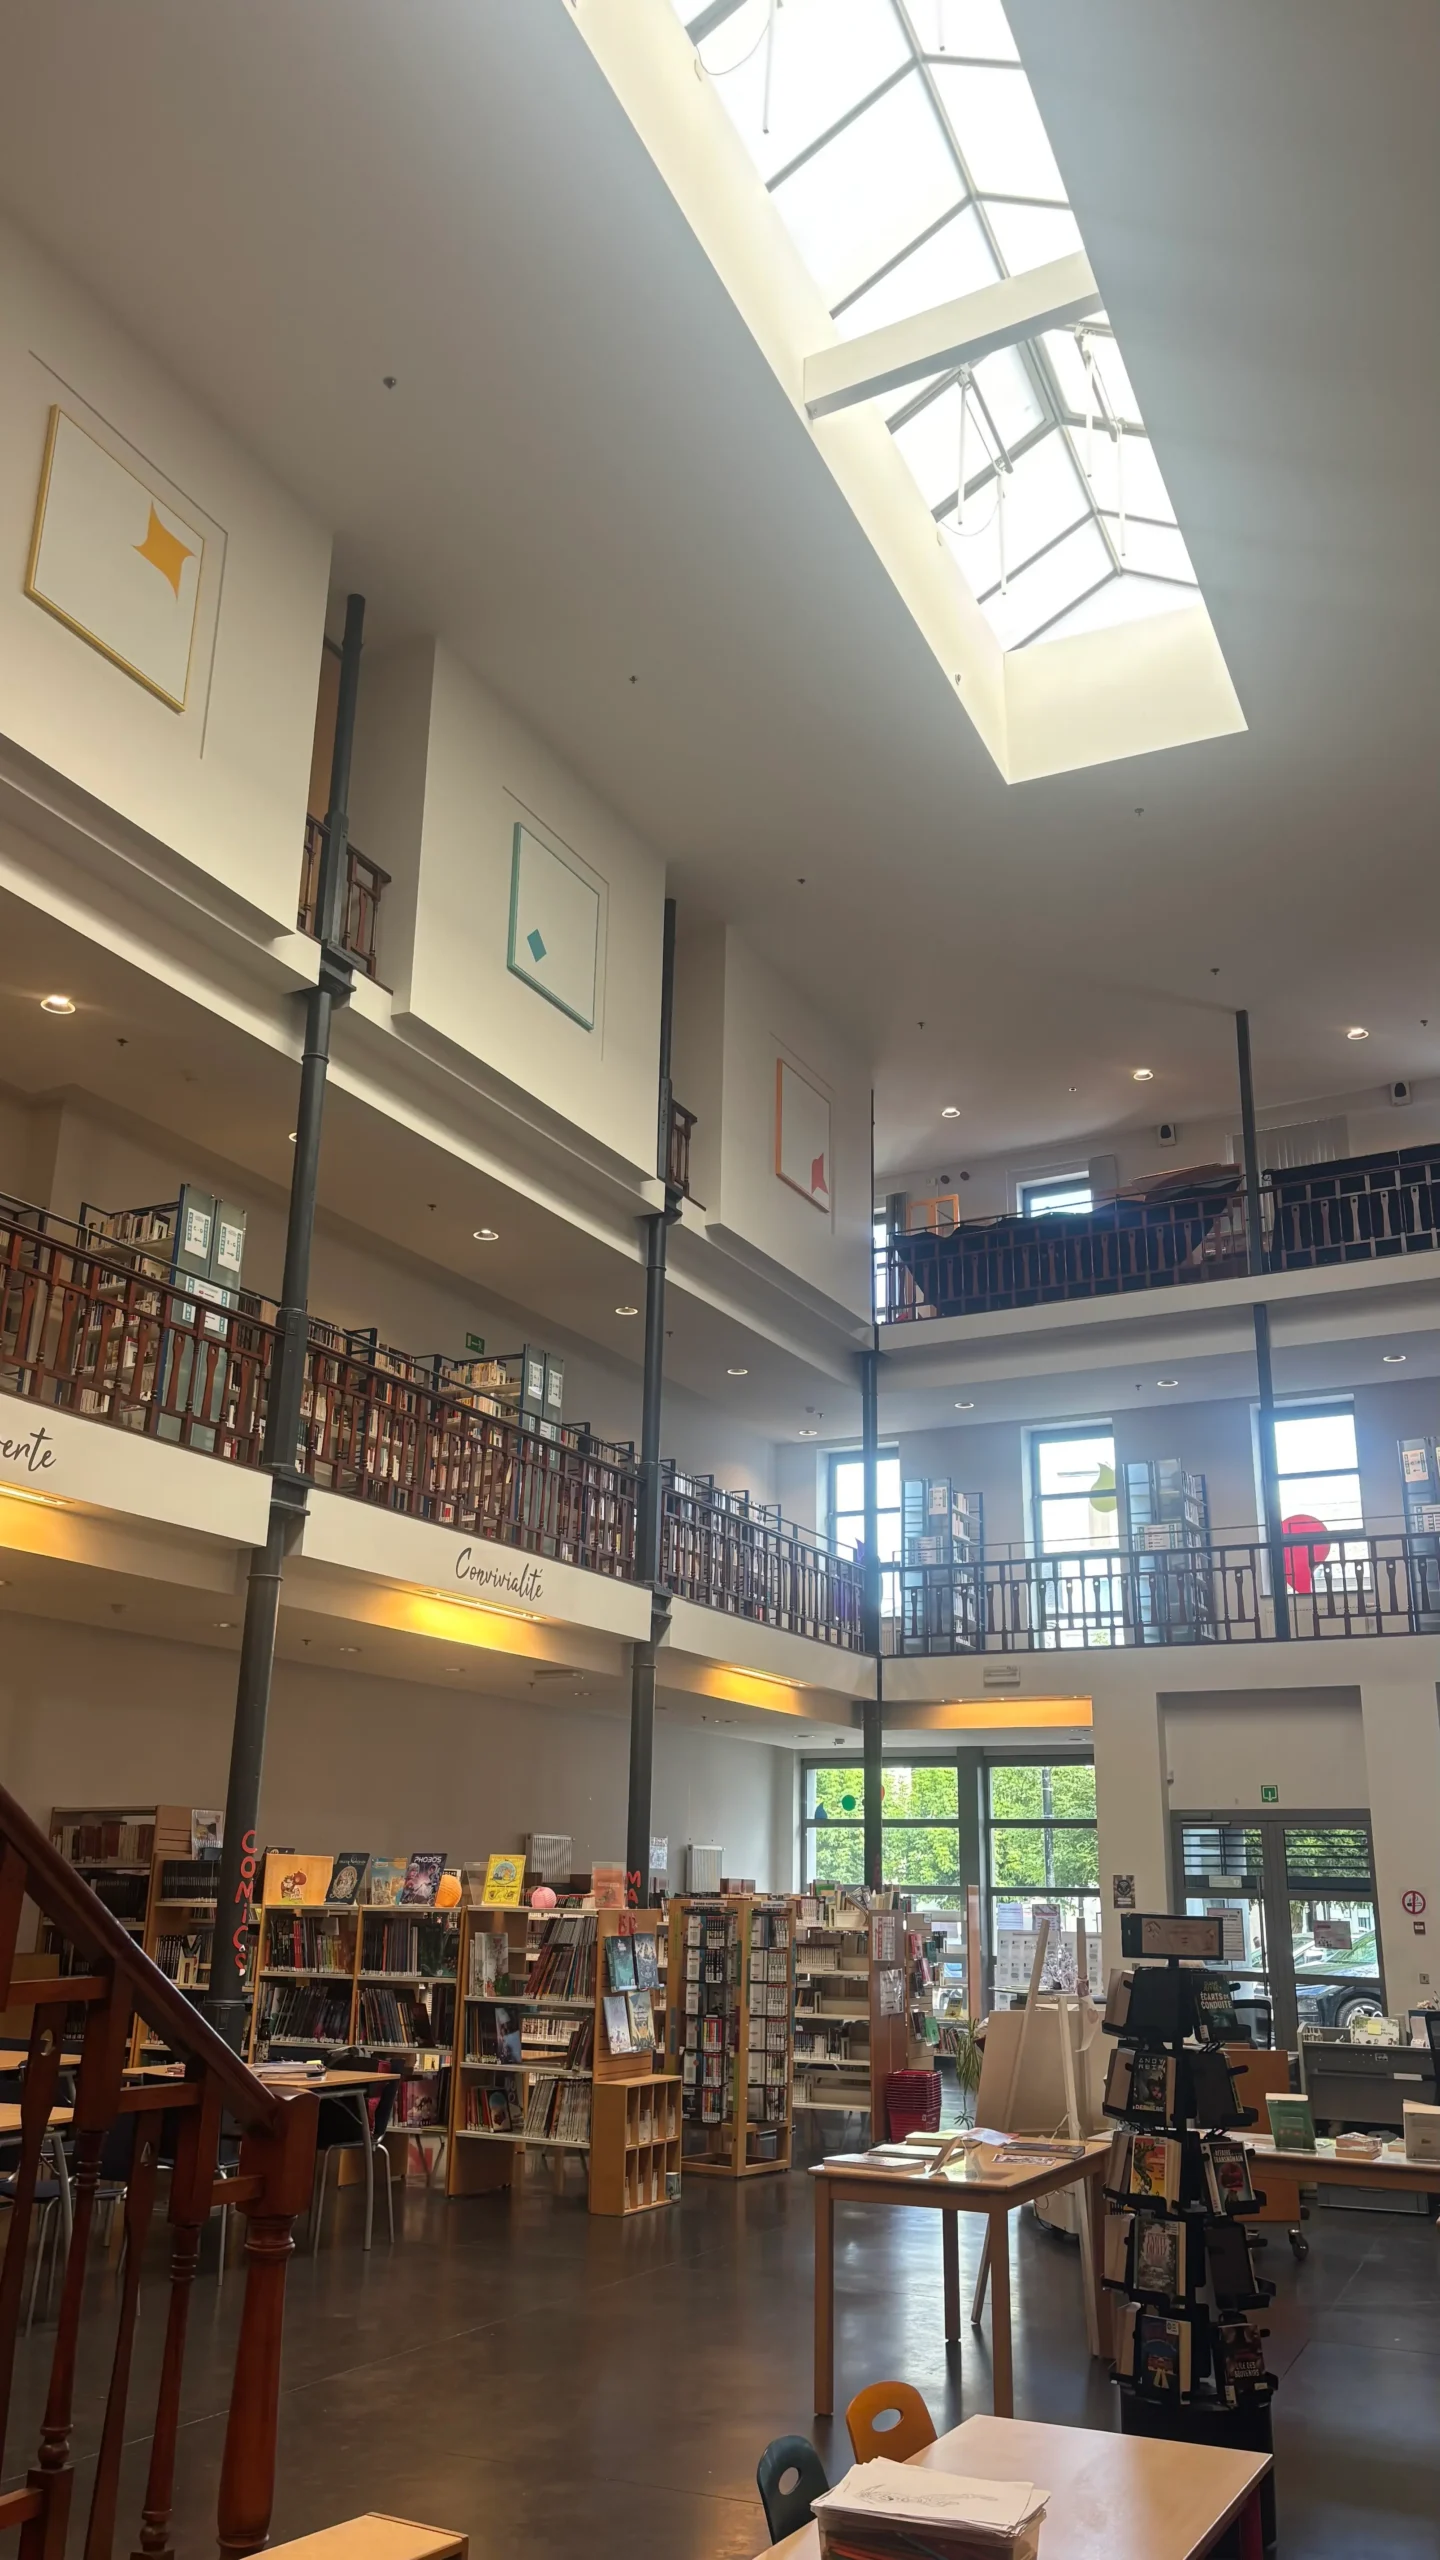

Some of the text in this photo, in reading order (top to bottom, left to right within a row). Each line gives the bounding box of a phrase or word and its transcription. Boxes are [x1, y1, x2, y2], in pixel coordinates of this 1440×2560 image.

[0, 1427, 57, 1472] erte
[455, 1547, 544, 1602] Convivialité
[1200, 1991, 1224, 2001] ÉCARTS
[1201, 2000, 1232, 2010] CONDUITE
